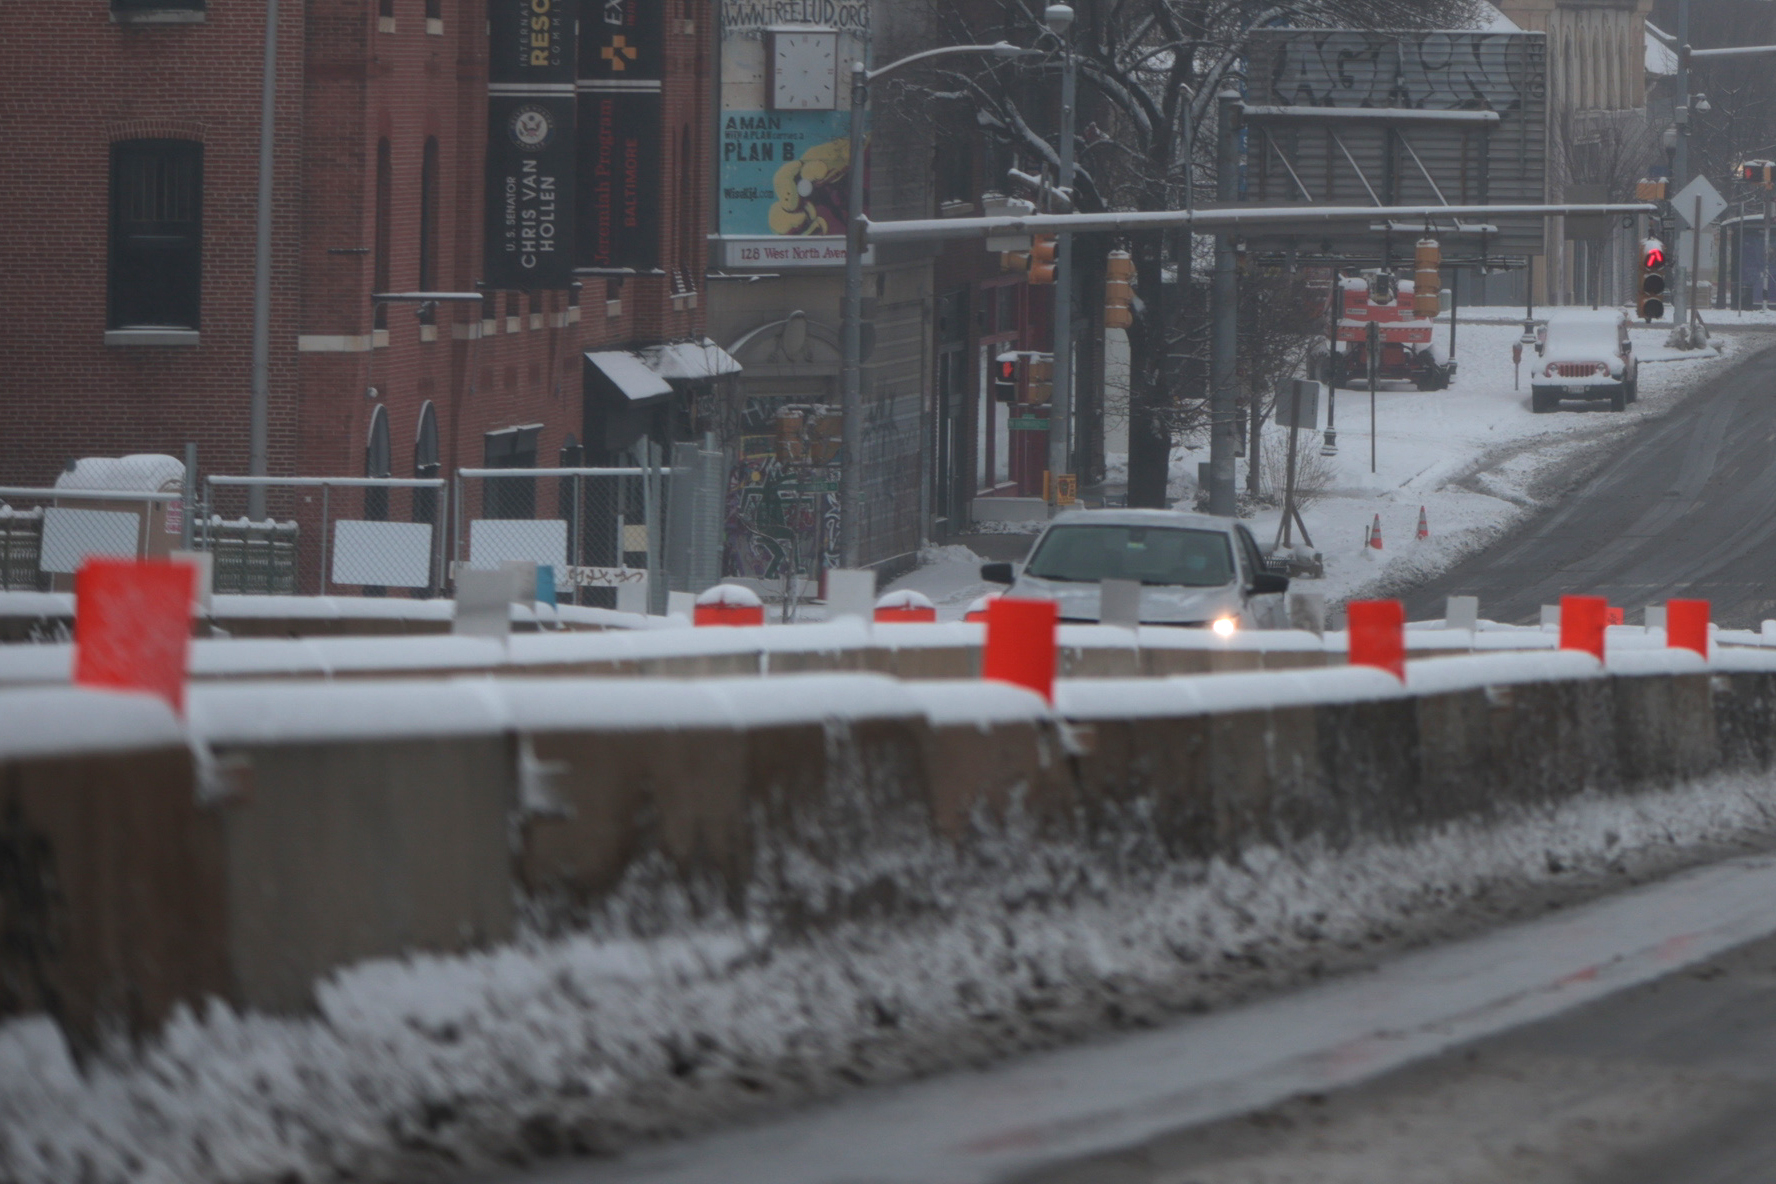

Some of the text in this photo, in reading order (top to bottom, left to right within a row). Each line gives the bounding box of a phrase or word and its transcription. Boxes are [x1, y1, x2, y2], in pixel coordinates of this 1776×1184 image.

[594, 98, 614, 266] Jeremiah Program
[624, 138, 639, 228] BALTIMORE
[725, 142, 795, 161] PLAN B
[506, 176, 517, 225] SENATOR
[521, 160, 538, 268] CHRIS VAN
[539, 176, 555, 252] HOLLEN
[741, 247, 761, 260] 128
[763, 247, 793, 260] West
[793, 246, 820, 260] North
